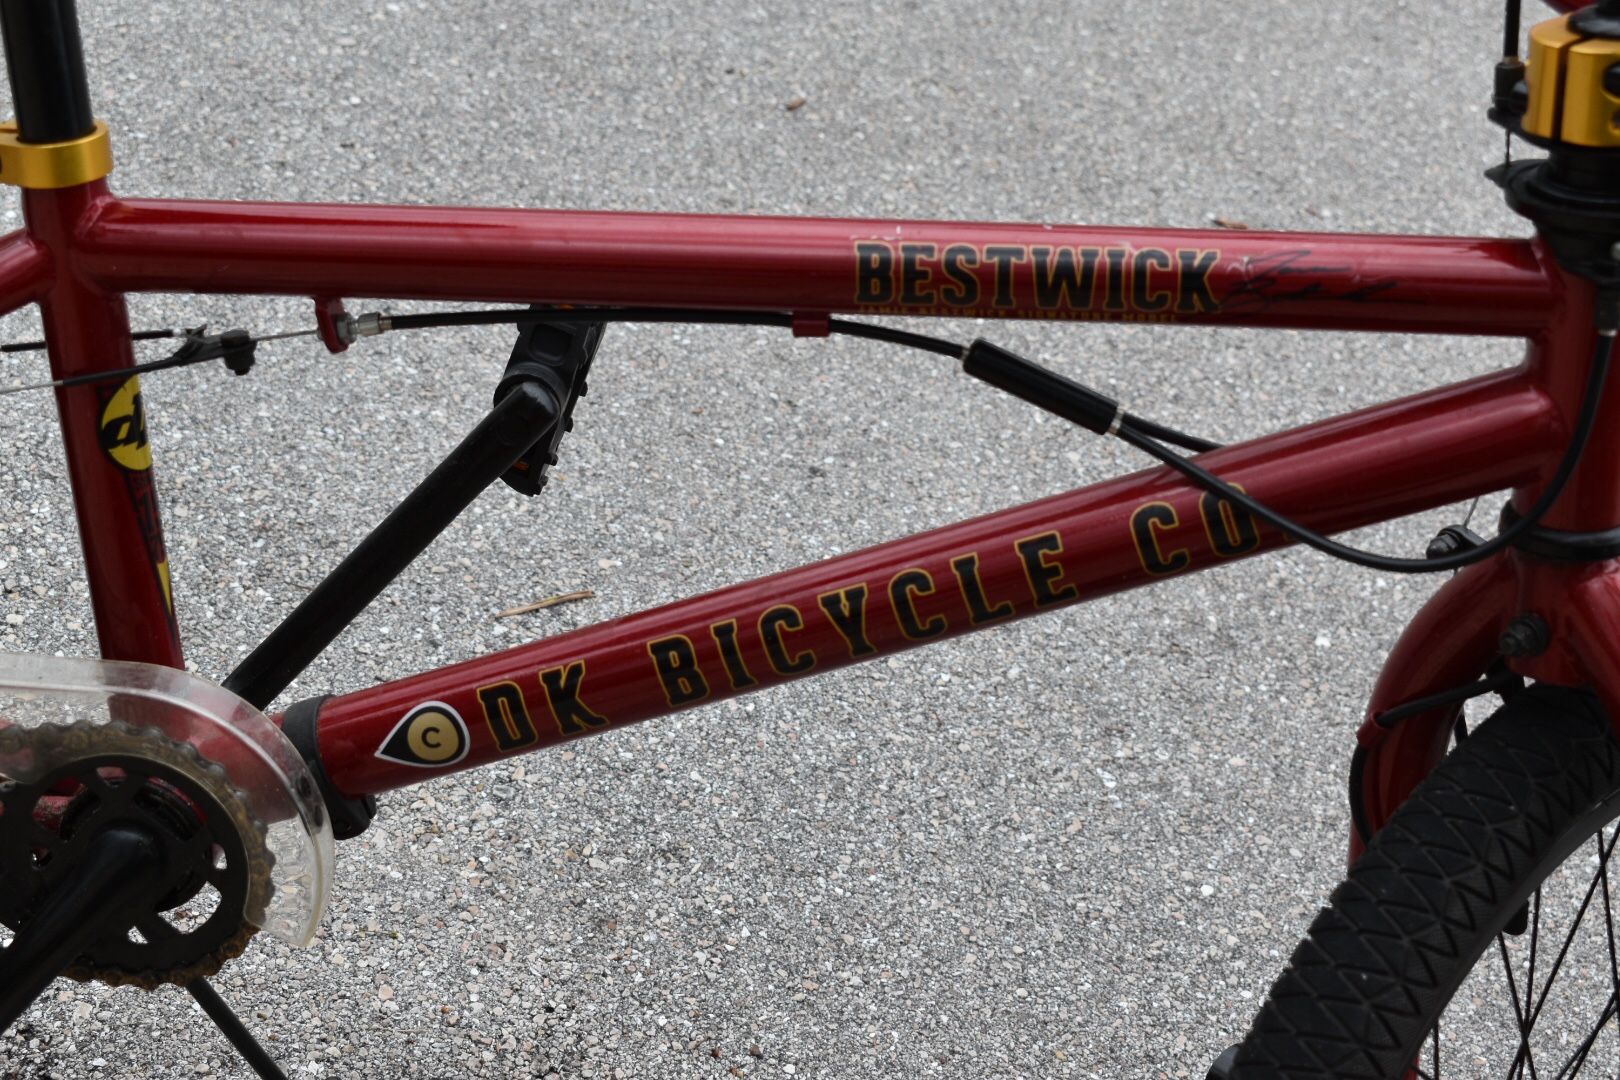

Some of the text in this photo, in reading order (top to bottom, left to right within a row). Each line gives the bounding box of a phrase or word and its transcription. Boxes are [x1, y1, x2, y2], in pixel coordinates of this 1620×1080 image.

[854, 241, 1222, 313] BESTWICK
[477, 482, 1285, 752] DK BICYCLE CO
